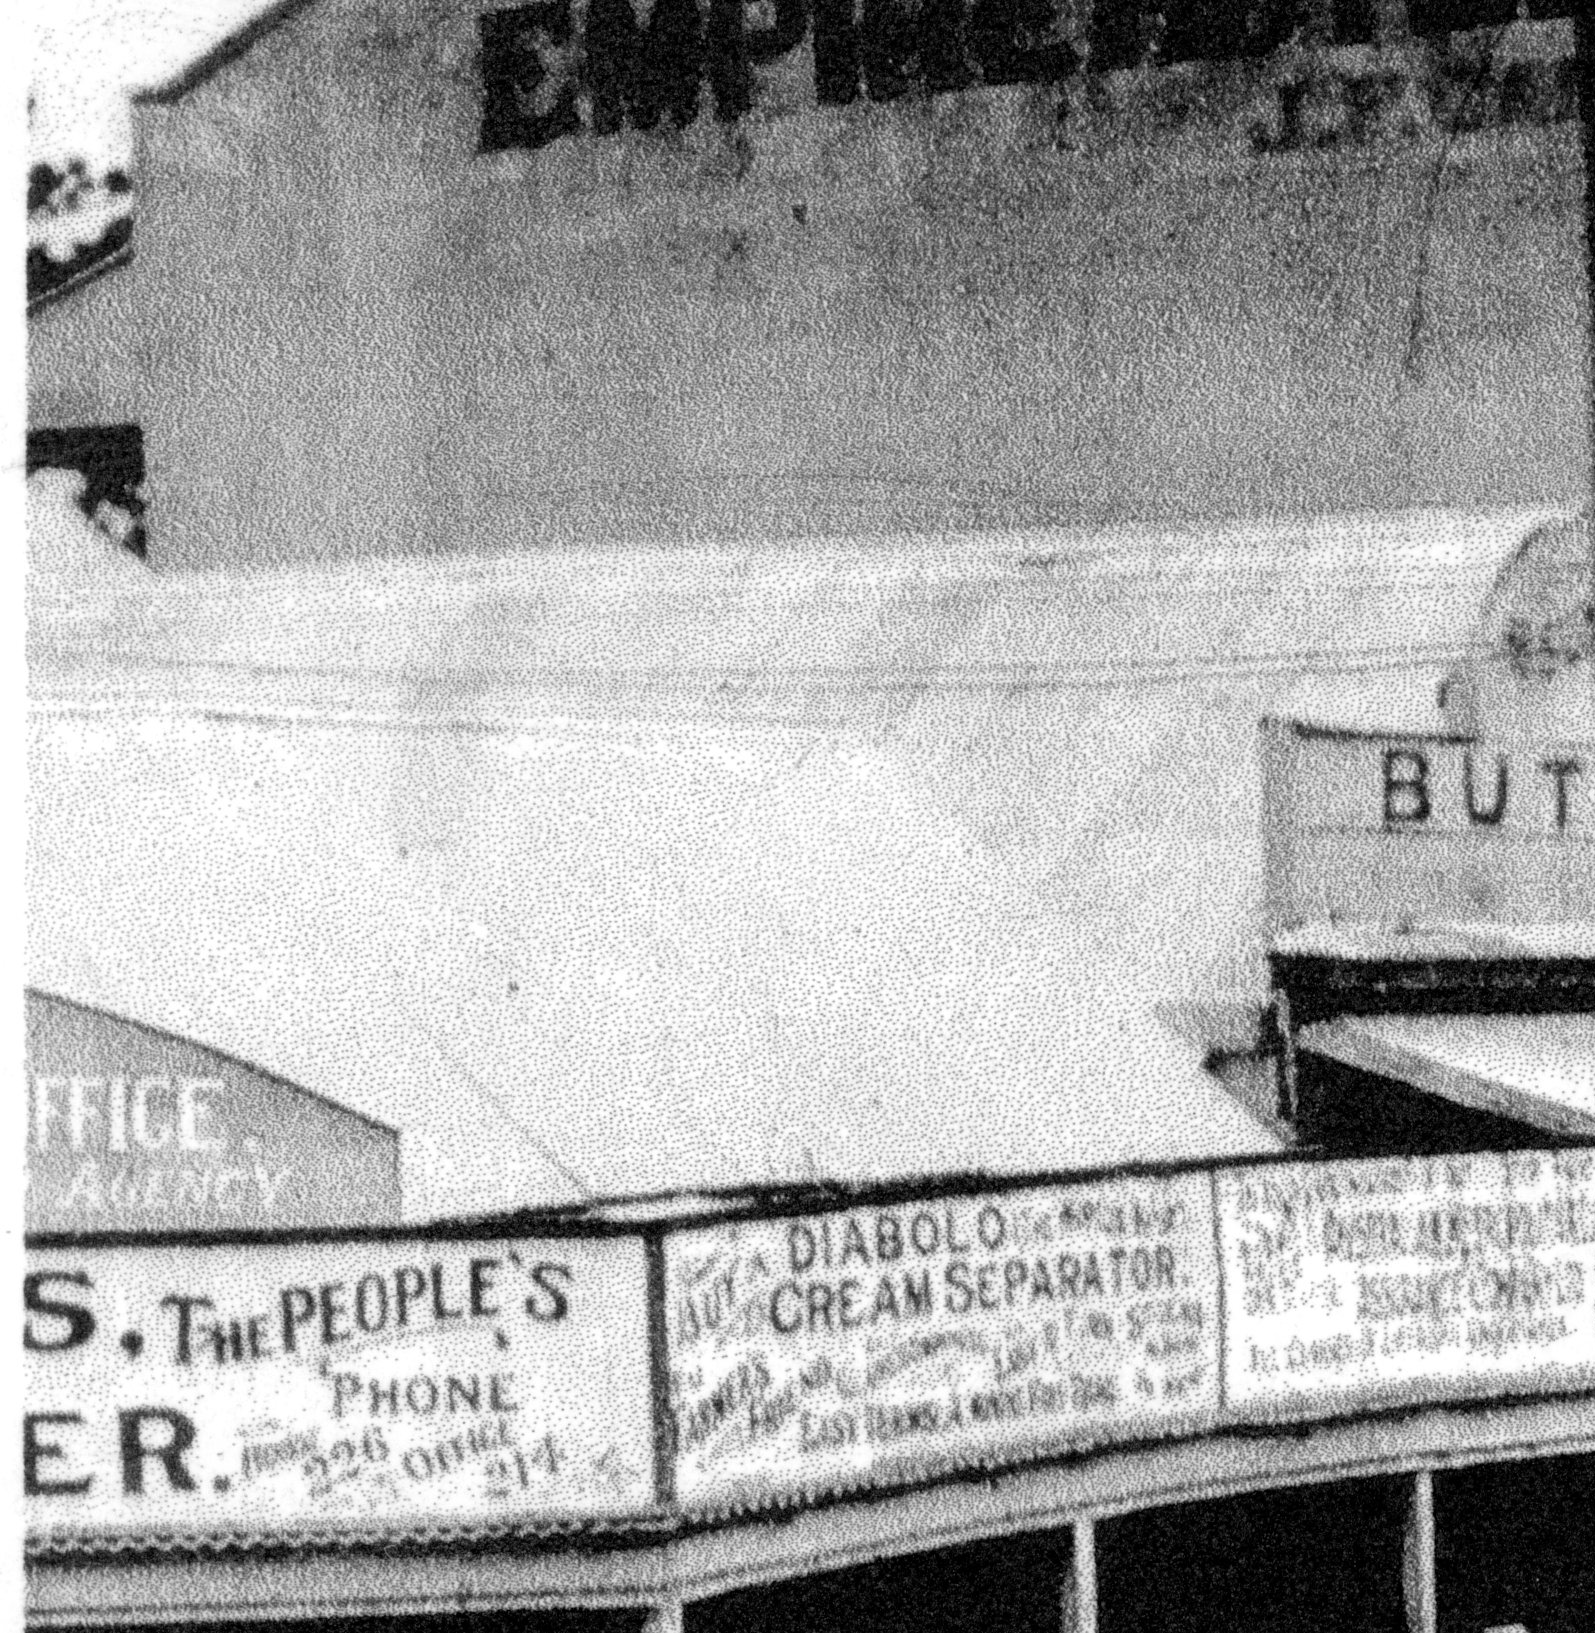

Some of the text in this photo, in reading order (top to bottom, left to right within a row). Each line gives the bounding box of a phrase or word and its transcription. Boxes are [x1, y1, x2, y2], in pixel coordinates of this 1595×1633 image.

[787, 1206, 1008, 1274] DIABOLO
[160, 1293, 273, 1367] THE
[279, 1248, 575, 1356] PEOPLE'S
[769, 1267, 934, 1335] CREAM
[943, 1243, 1192, 1315] SEPARATOR.
